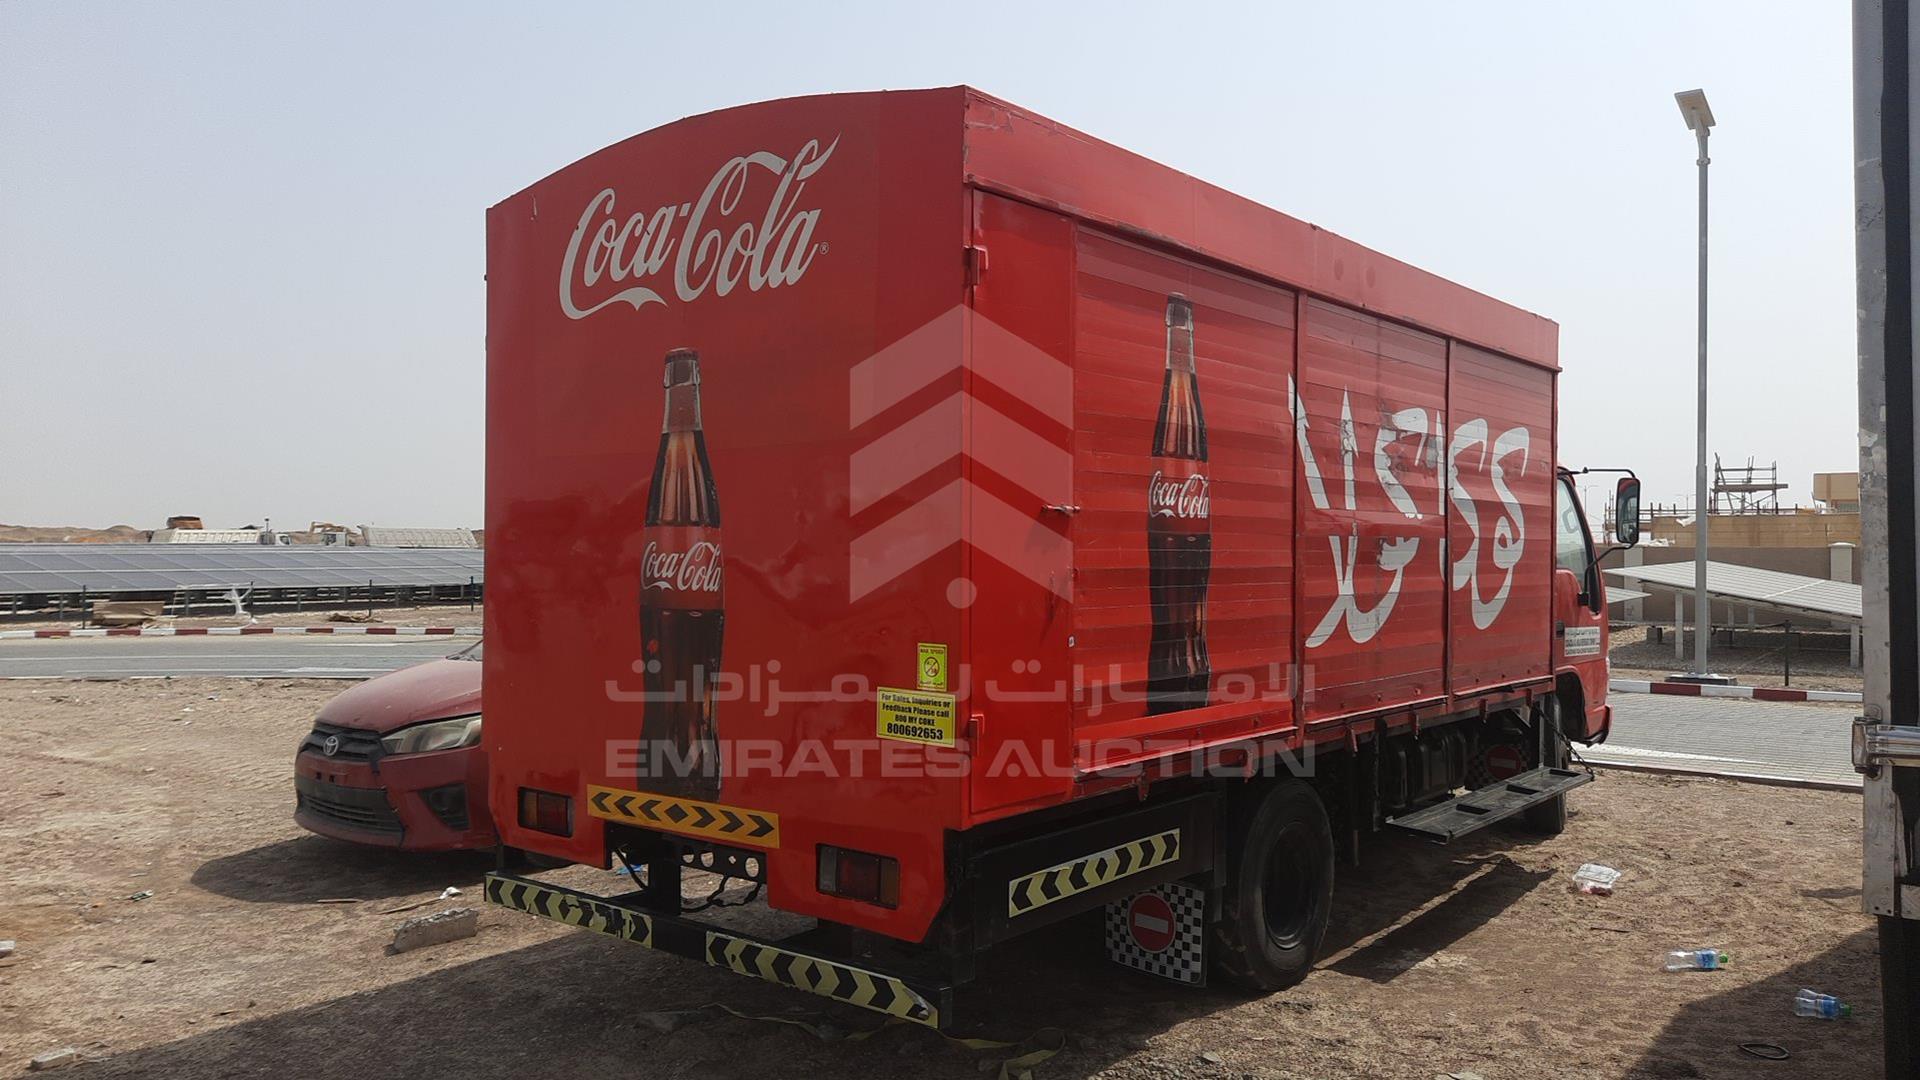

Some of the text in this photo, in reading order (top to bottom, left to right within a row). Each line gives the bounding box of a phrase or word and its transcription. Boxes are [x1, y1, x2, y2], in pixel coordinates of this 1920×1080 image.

[559, 132, 841, 320] Coca-Cola
[1148, 470, 1209, 519] Coca-Cola
[640, 541, 721, 592] Coca-Cola
[881, 692, 892, 701] For
[882, 703, 950, 718] Feedback Please call
[894, 714, 935, 726] 800 MY COKE
[887, 722, 944, 740] 800692653
